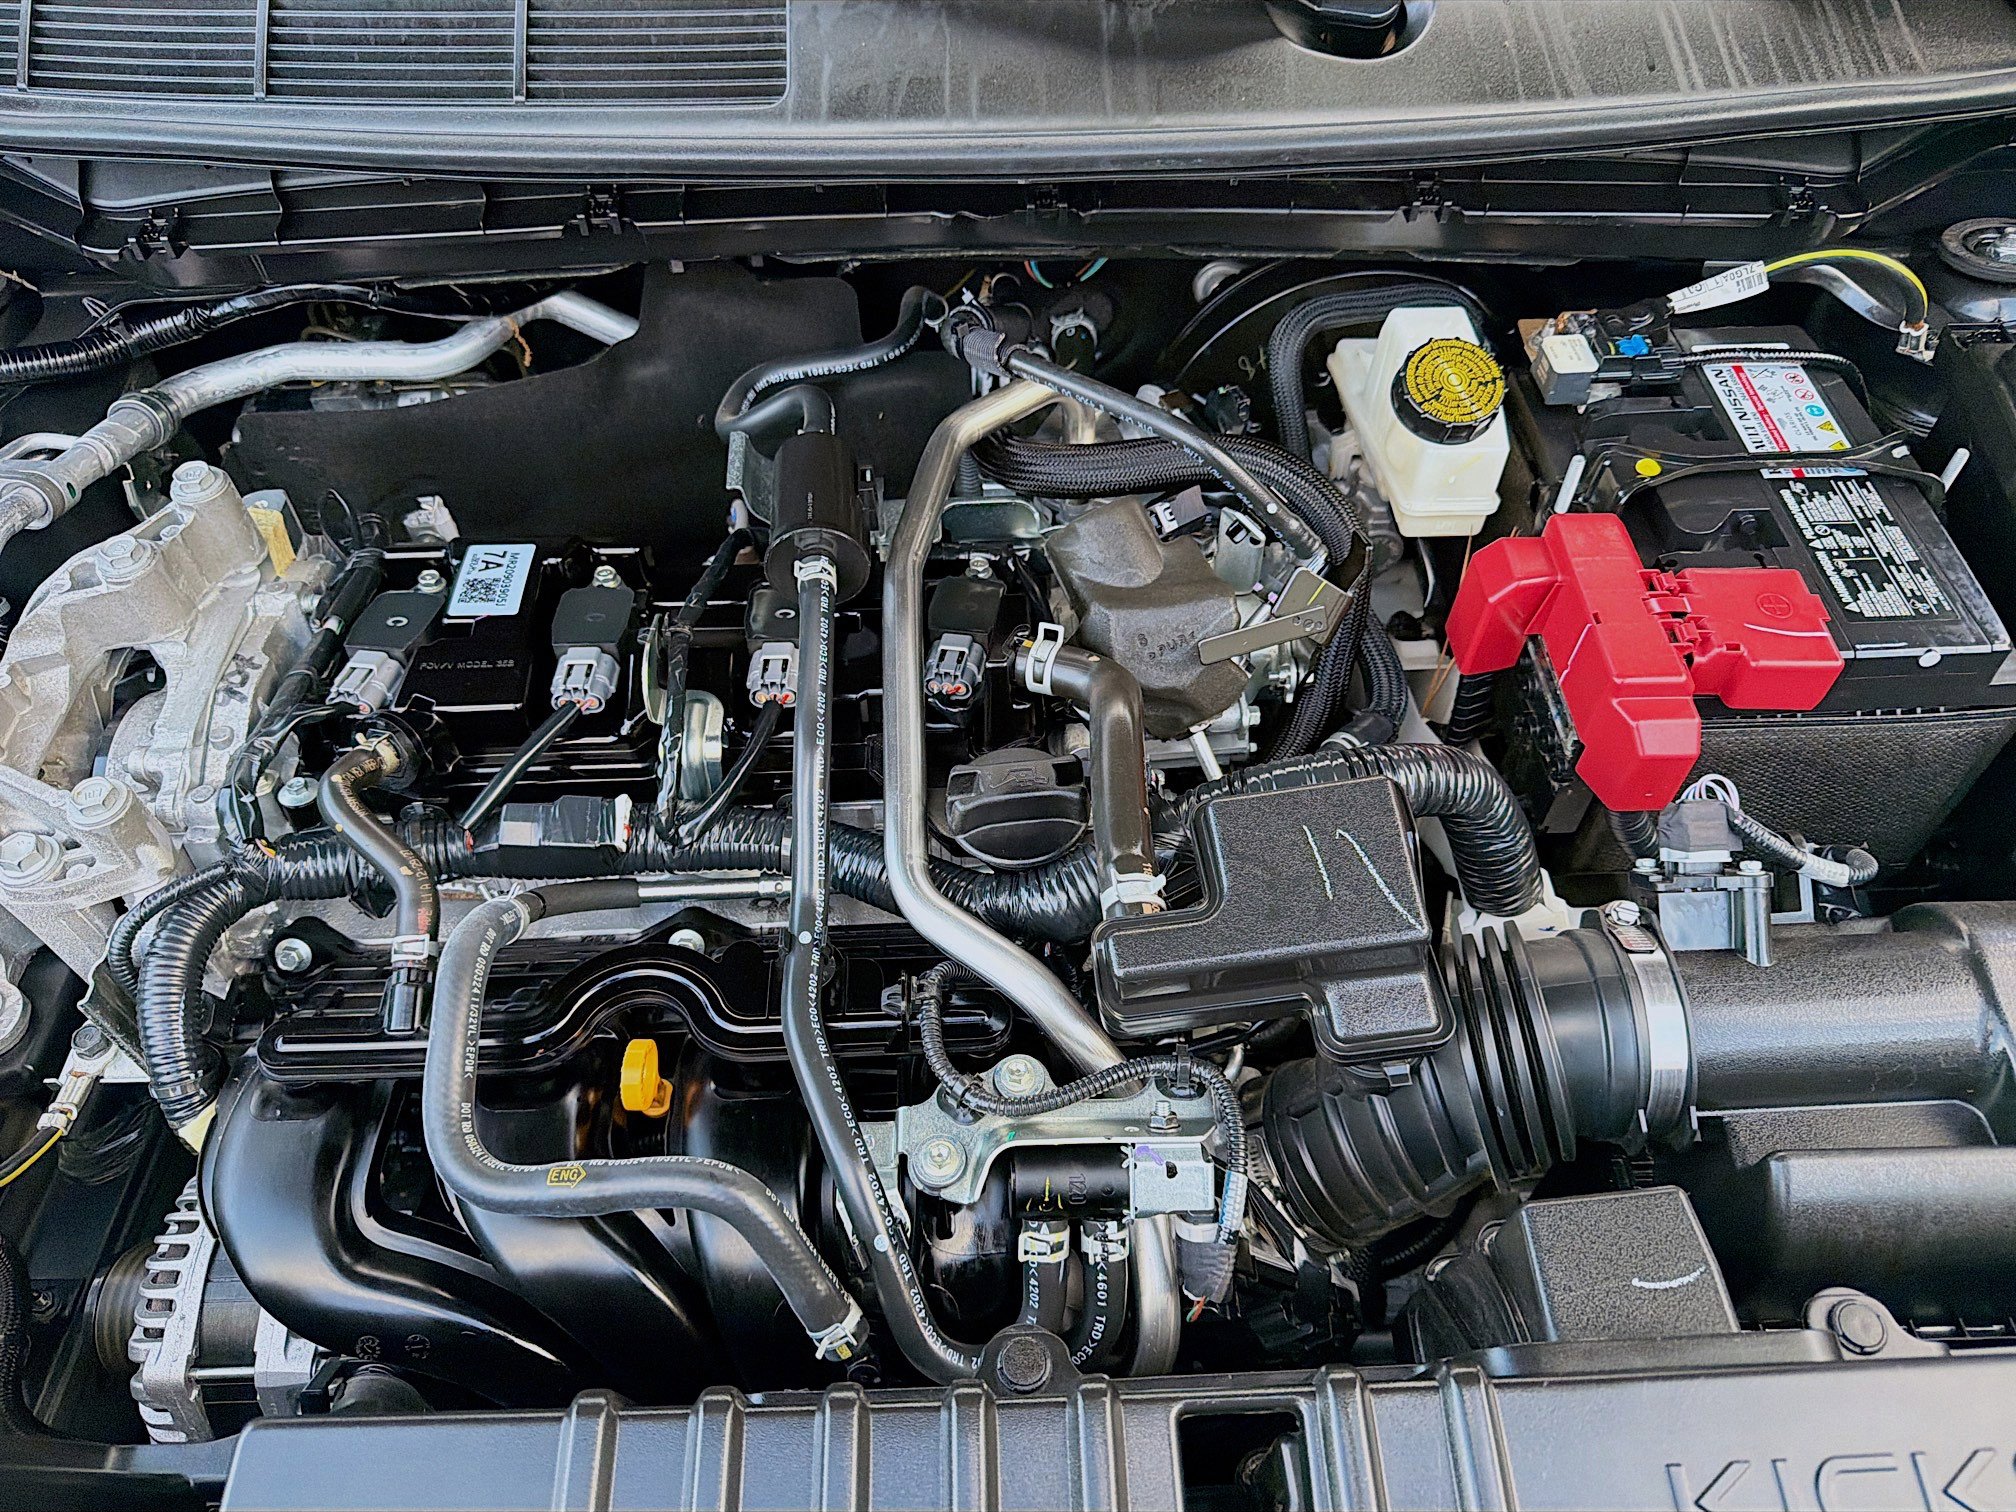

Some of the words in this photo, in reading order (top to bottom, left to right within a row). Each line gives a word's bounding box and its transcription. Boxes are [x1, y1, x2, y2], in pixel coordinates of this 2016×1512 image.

[1711, 369, 1751, 421] NISSAN
[478, 550, 508, 572] 7A
[1815, 551, 1853, 602] DANGER/POISON
[818, 617, 829, 686] TRD>ECO<4202
[815, 691, 827, 786] TRD>ECO<4202
[815, 788, 826, 880] TRD>ECO<4202
[400, 849, 430, 881] 12:29:27
[810, 888, 826, 968] TRD>ECO<4202
[472, 956, 487, 995] 050324
[808, 972, 830, 1059] TRD>ECO<4202
[464, 1040, 476, 1079] >EPDM<
[461, 1102, 472, 1119] DOT
[826, 1065, 870, 1165] TRD>ECO<4202
[550, 1168, 579, 1182] ENG
[909, 1288, 966, 1368] TRD>ECO<4202
